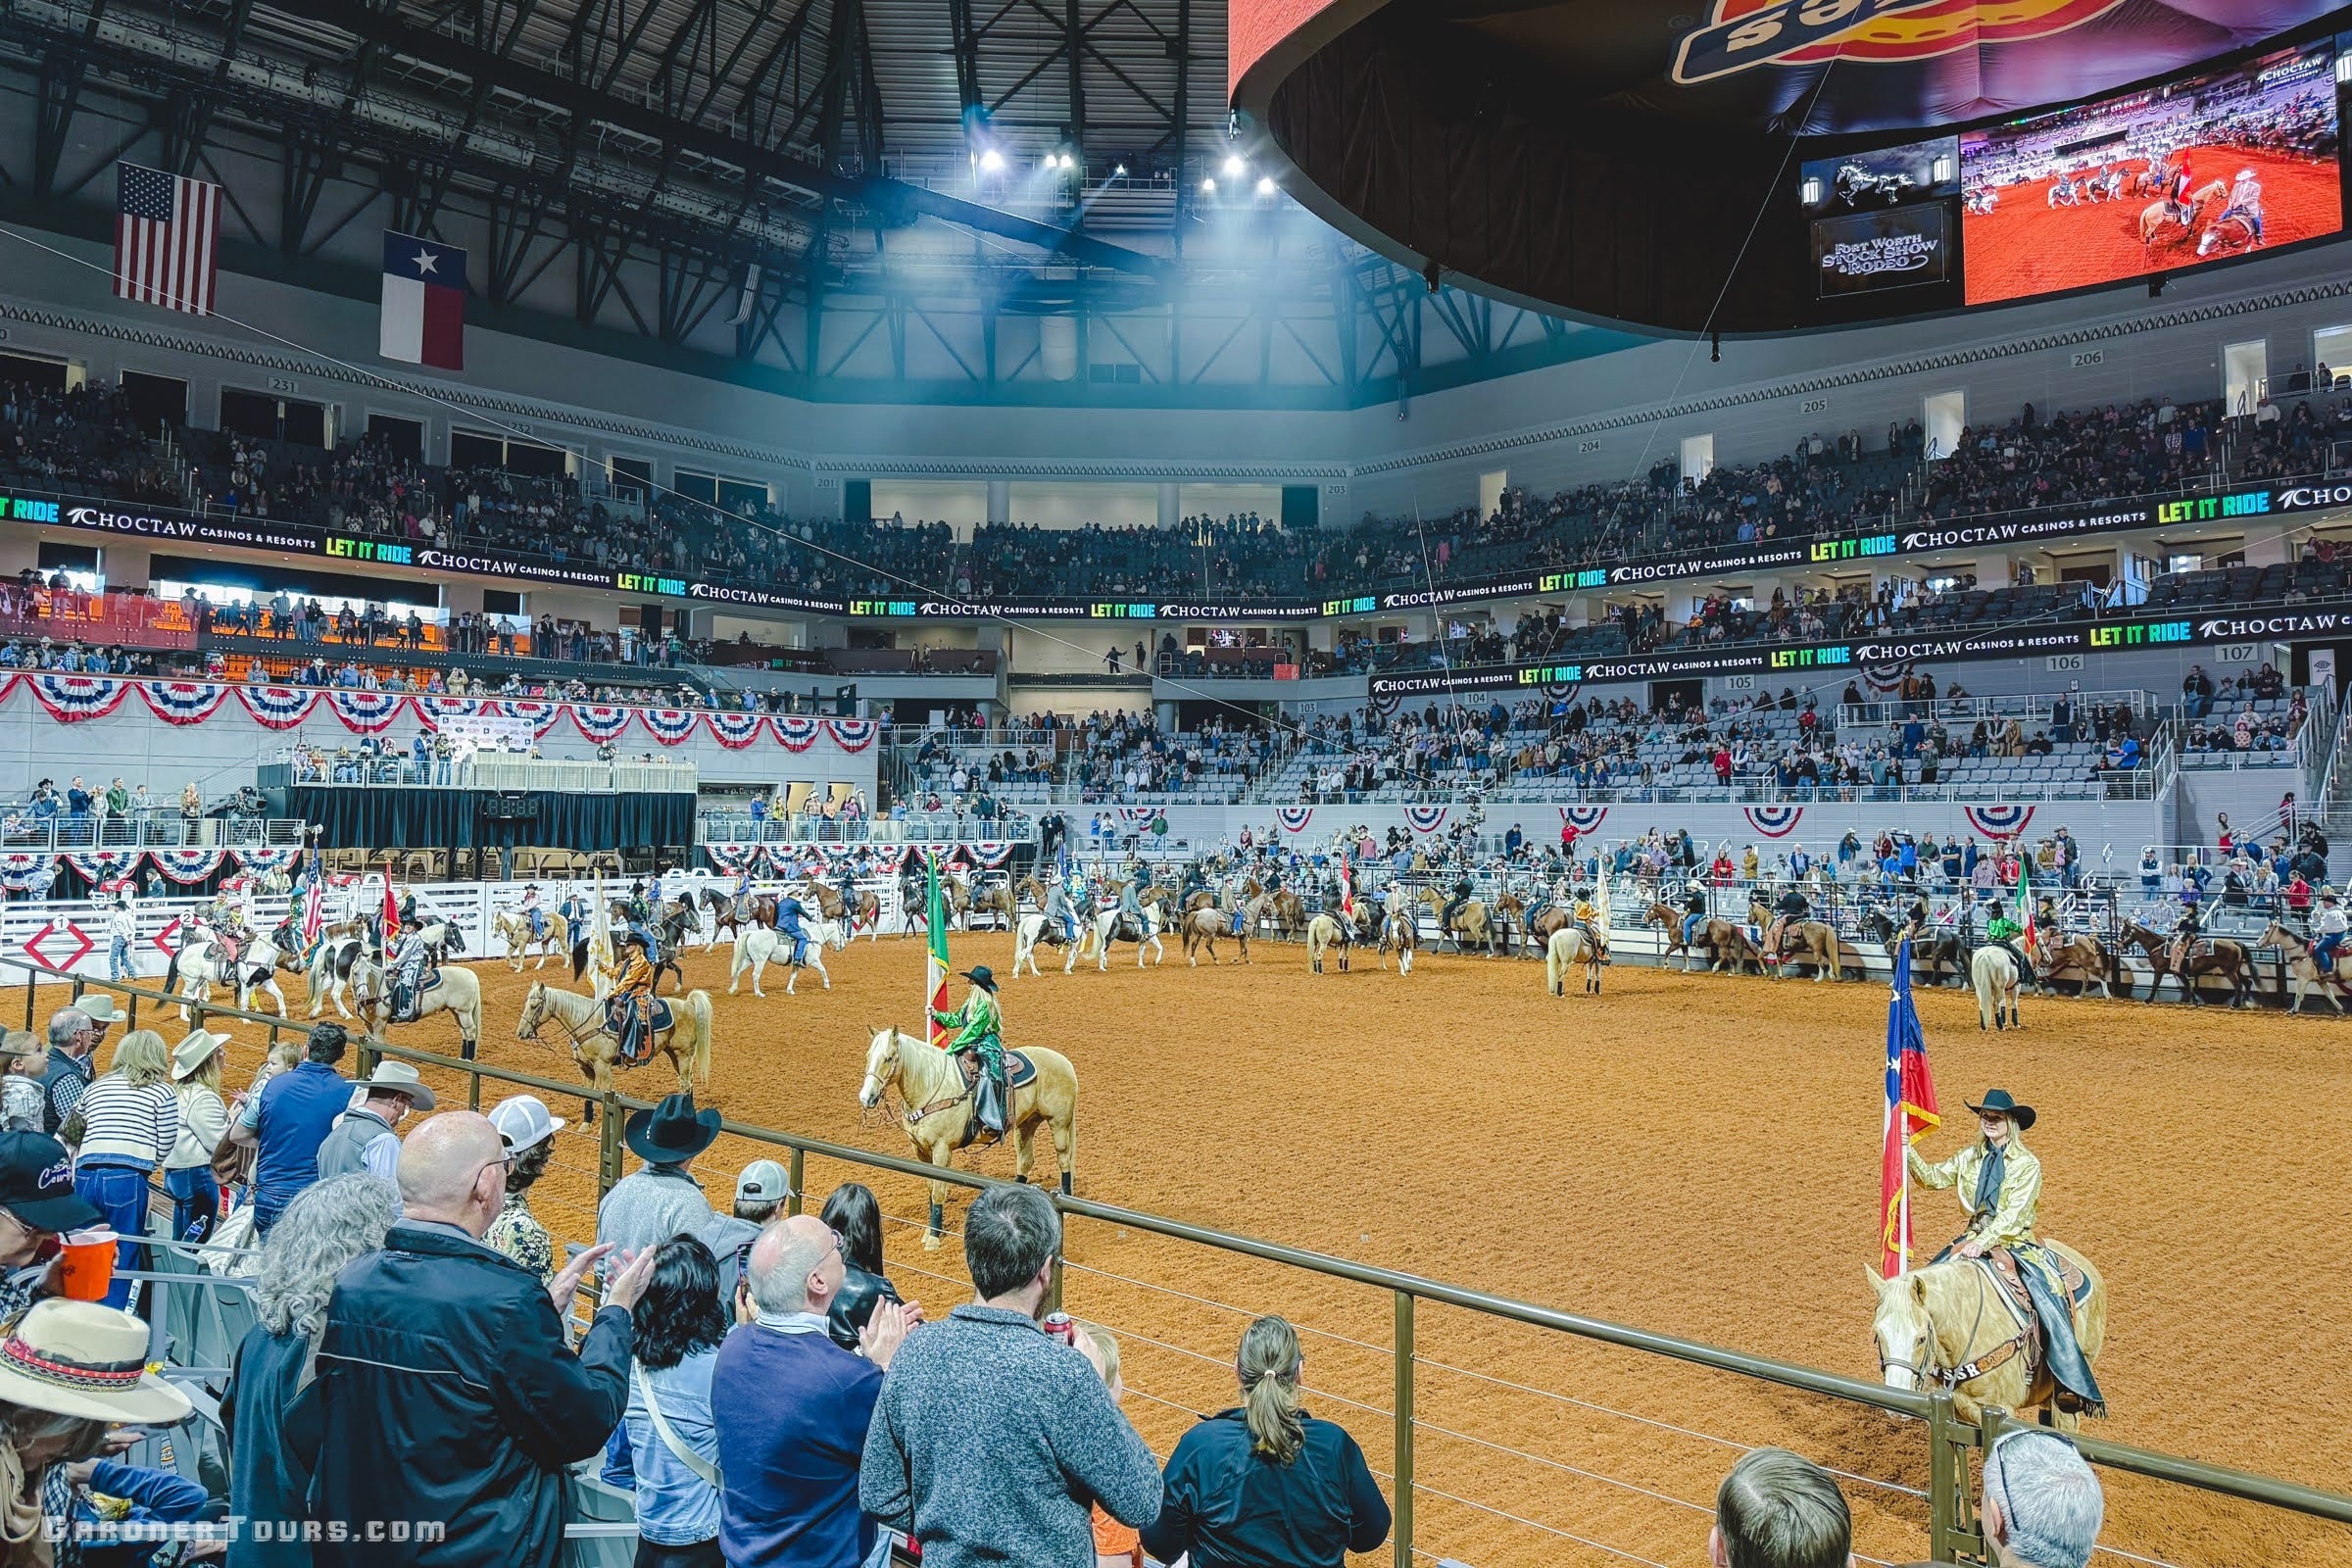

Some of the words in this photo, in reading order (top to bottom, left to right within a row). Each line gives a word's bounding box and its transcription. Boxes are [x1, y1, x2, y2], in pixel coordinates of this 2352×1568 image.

[2265, 58, 2322, 81] CHOCTAW
[1822, 250, 1882, 268] STOCK
[1884, 240, 1937, 257] SHOW
[1848, 257, 1909, 275] RODEO
[2075, 351, 2101, 367] 206
[273, 378, 295, 391] 231
[1804, 400, 1826, 413] 205
[512, 424, 531, 434] 232
[1581, 441, 1599, 453] 204
[1328, 485, 1346, 494] 203
[2292, 487, 2352, 506] CHO
[13, 500, 60, 522] RIDE
[2158, 500, 2193, 523] LET
[2199, 498, 2217, 519] IT
[2223, 491, 2271, 516] RIDE
[81, 509, 196, 537] CHOCTAW
[200, 527, 252, 541] CASINOS
[267, 535, 317, 549] RESORTS
[1914, 523, 2017, 548] CHOCTAW
[2022, 519, 2074, 534] CASINOS
[2079, 518, 2086, 527] &
[2089, 512, 2146, 526] RESORTS
[326, 537, 355, 557] LET
[358, 542, 373, 560] IT
[377, 543, 412, 564] RIDE
[1811, 541, 1838, 562] LET
[1841, 539, 1856, 559] IT
[1861, 534, 1895, 556] RIDE
[428, 551, 516, 574] CHOCTAW
[519, 565, 561, 577] CASINOS
[570, 572, 611, 583] RESORTS
[1620, 561, 1701, 581] CHOCTAW
[1704, 558, 1745, 568] CASINOS
[1758, 551, 1801, 563] RESORTS
[617, 573, 641, 590] LET
[643, 576, 656, 592] IT
[658, 578, 686, 596] RIDE
[1540, 575, 1560, 592] LET
[1563, 573, 1575, 589] IT
[1578, 568, 1606, 587] RIDE
[698, 584, 768, 604] CHOCTAW
[770, 596, 803, 606] CASINOS
[810, 601, 843, 611] RESORTS
[1392, 589, 1454, 607] CHOCTAW
[1456, 587, 1490, 597] CASINOS
[1498, 582, 1533, 593] RESORTS
[850, 601, 872, 614] LET
[874, 601, 885, 614] IT
[889, 602, 916, 615] RIDE
[929, 603, 1002, 615] CHOCTAW
[1091, 604, 1112, 617] LET
[1114, 604, 1126, 617] IT
[1128, 604, 1155, 617] RIDE
[1168, 605, 1241, 617] CHOCTAW
[1323, 602, 1341, 616] LET
[1342, 600, 1351, 613] IT
[1353, 596, 1376, 612] RIDE
[2090, 625, 2123, 647] LET
[2127, 624, 2144, 644] IT
[2149, 621, 2191, 643] RIDE
[2211, 614, 2336, 637] CHOCTAW
[1771, 651, 1796, 667] LET
[1799, 650, 1813, 665] IT
[1817, 646, 1850, 664] RIDE
[1867, 642, 1961, 660] CHOCTAW
[1966, 639, 2014, 651] CASINOS
[2028, 635, 2080, 646] RESORTS
[2221, 646, 2252, 661] 107
[1594, 662, 1670, 677] CHOCTAW
[1672, 661, 1711, 670] CASINOS
[1722, 657, 1762, 667] RESORTS
[2050, 656, 2080, 669] 106
[1379, 678, 1440, 692] CHOCTAW
[1442, 677, 1472, 686] CASINOS
[1480, 674, 1512, 683] RESORTS
[1519, 669, 1540, 684] LET
[1542, 667, 1552, 682] IT
[1555, 665, 1581, 681] RIDE
[1730, 676, 1751, 689] 105
[1467, 693, 1486, 703] 104
[1300, 704, 1315, 712] 103
[59, 918, 64, 928] 1
[183, 913, 191, 922] 2
